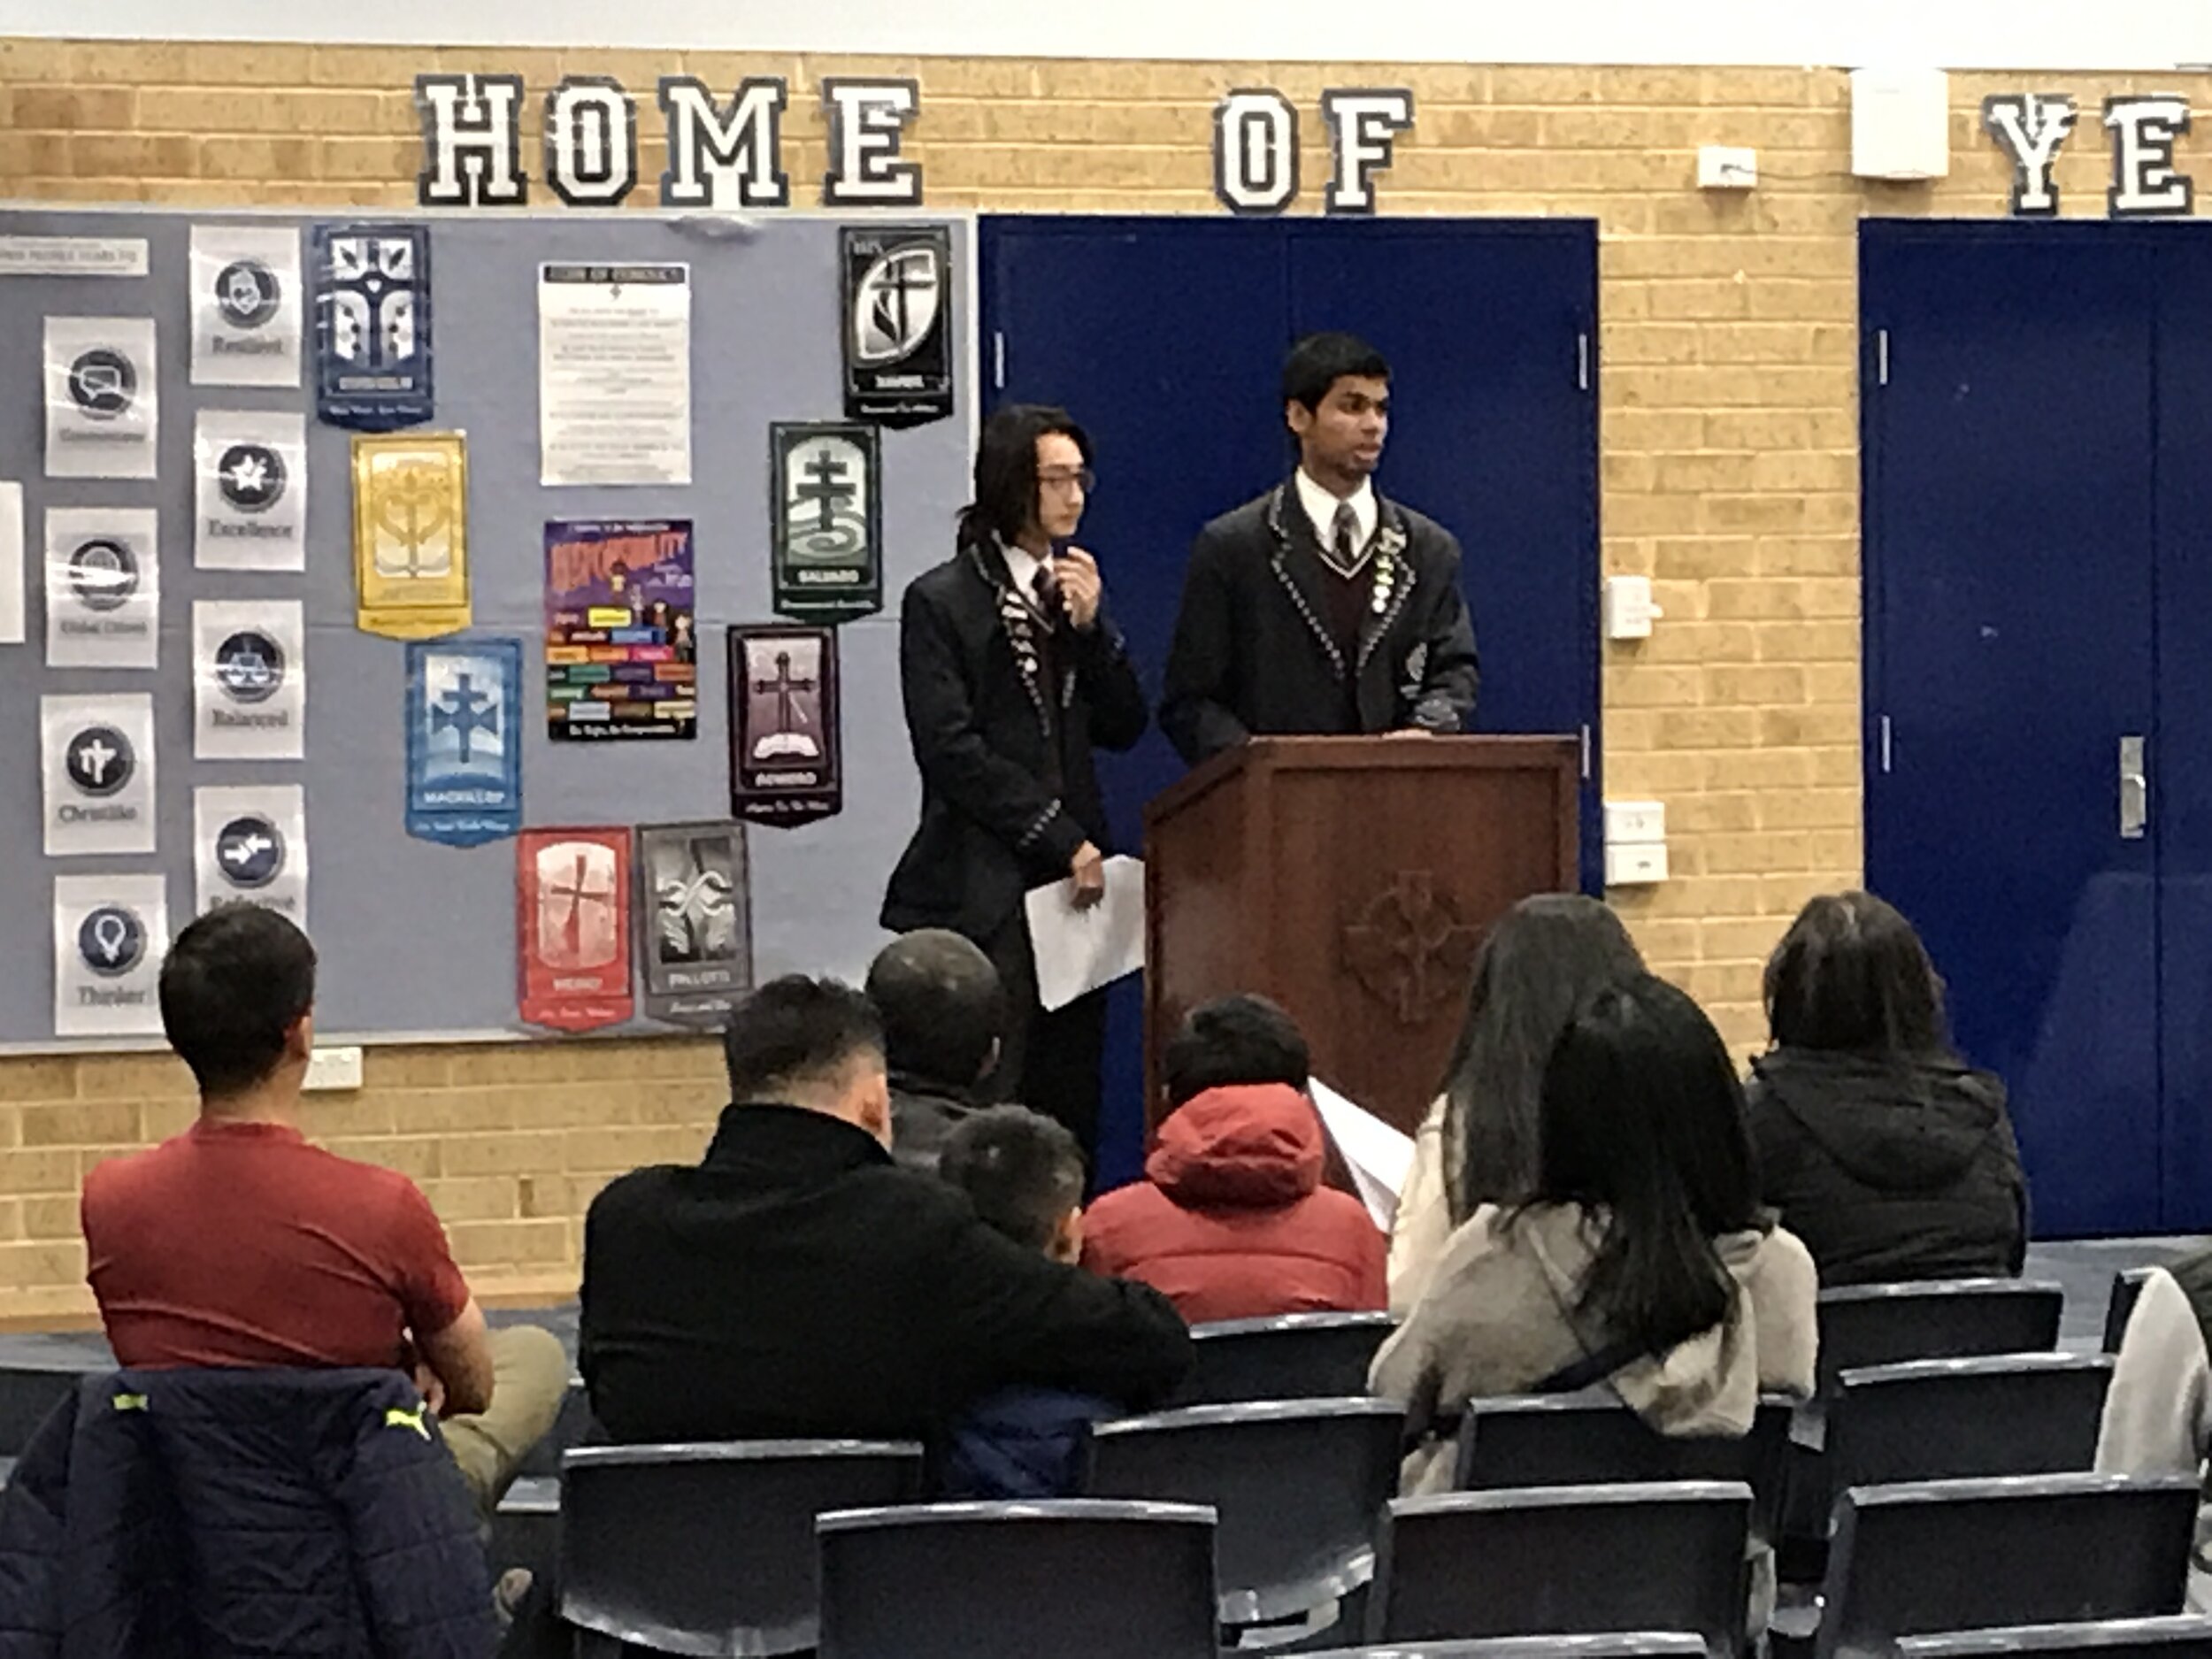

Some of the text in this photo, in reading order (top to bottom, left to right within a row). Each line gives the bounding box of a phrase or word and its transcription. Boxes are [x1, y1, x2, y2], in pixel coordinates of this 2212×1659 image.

[415, 73, 922, 206] HOME
[1213, 88, 1413, 214] OF
[208, 520, 293, 537] Excellence
[212, 710, 288, 728] Balanced
[78, 985, 145, 1005] Thinker
